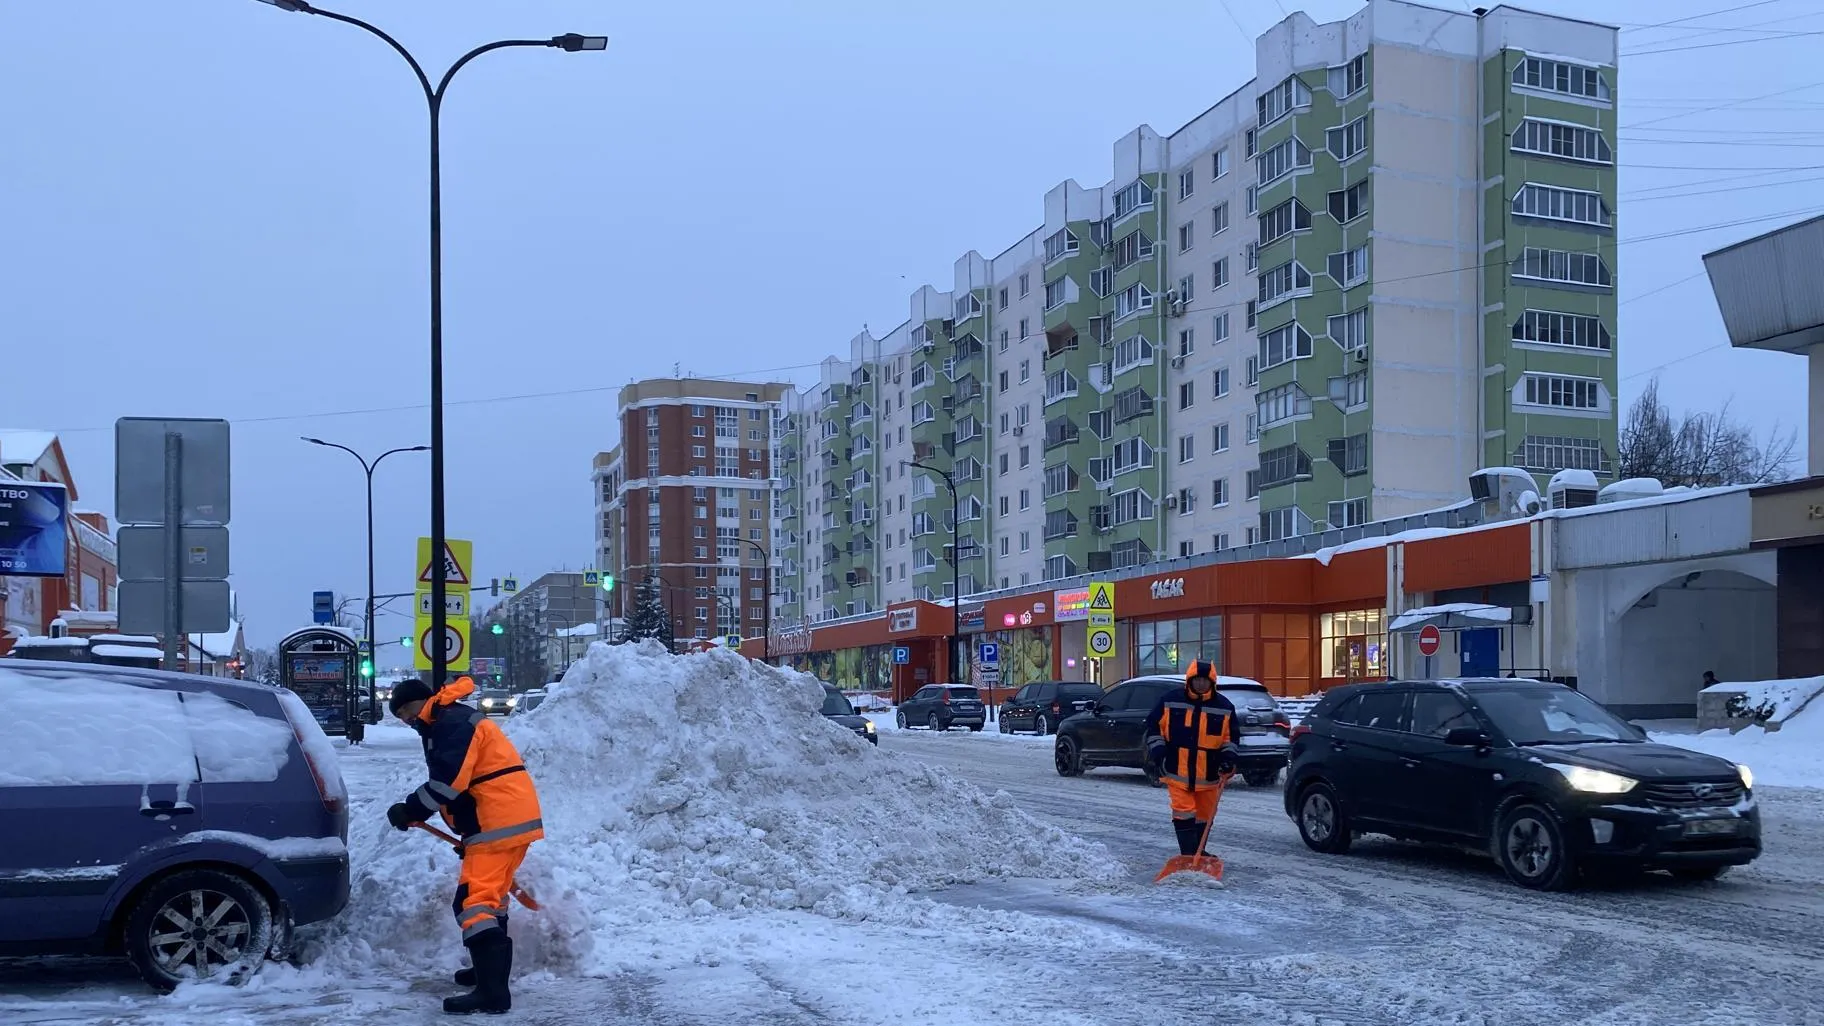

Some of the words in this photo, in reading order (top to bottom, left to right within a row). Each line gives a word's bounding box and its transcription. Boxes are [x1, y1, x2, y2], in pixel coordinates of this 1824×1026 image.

[0, 489, 29, 499] ТВО
[1096, 637, 1108, 647] 30
[896, 649, 906, 661] P
[983, 645, 995, 661] P
